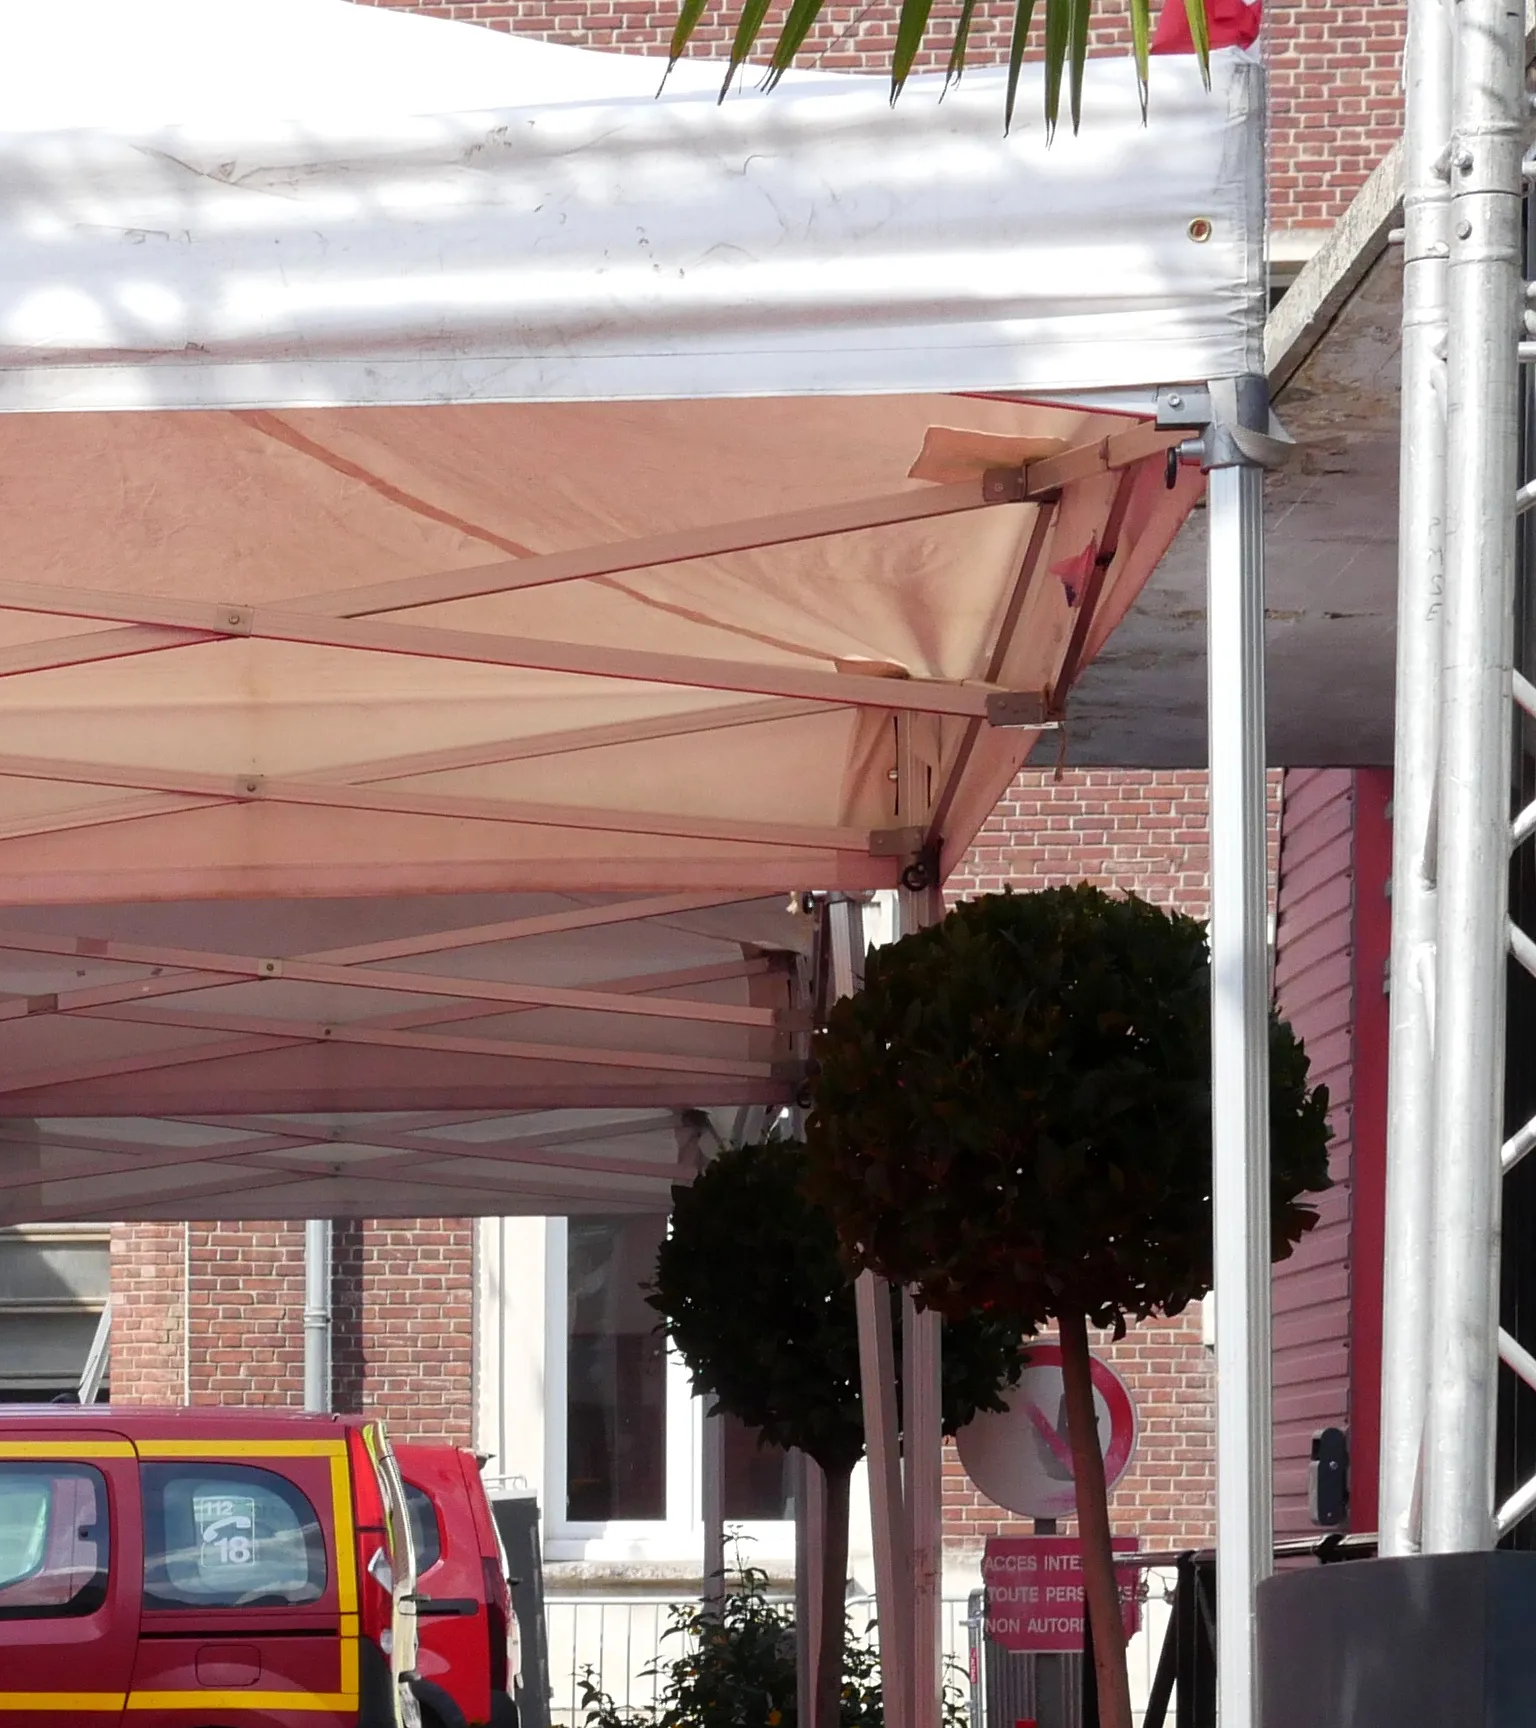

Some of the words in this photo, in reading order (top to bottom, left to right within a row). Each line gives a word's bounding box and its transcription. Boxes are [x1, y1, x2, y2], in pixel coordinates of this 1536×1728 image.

[205, 1501, 233, 1516] 112
[213, 1536, 250, 1563] 18
[984, 1555, 1037, 1571] ACCES
[1044, 1555, 1084, 1571] INTE
[988, 1586, 1039, 1602] TOUTE
[984, 1617, 1021, 1634] NON
[1027, 1617, 1085, 1634] AUTORI
